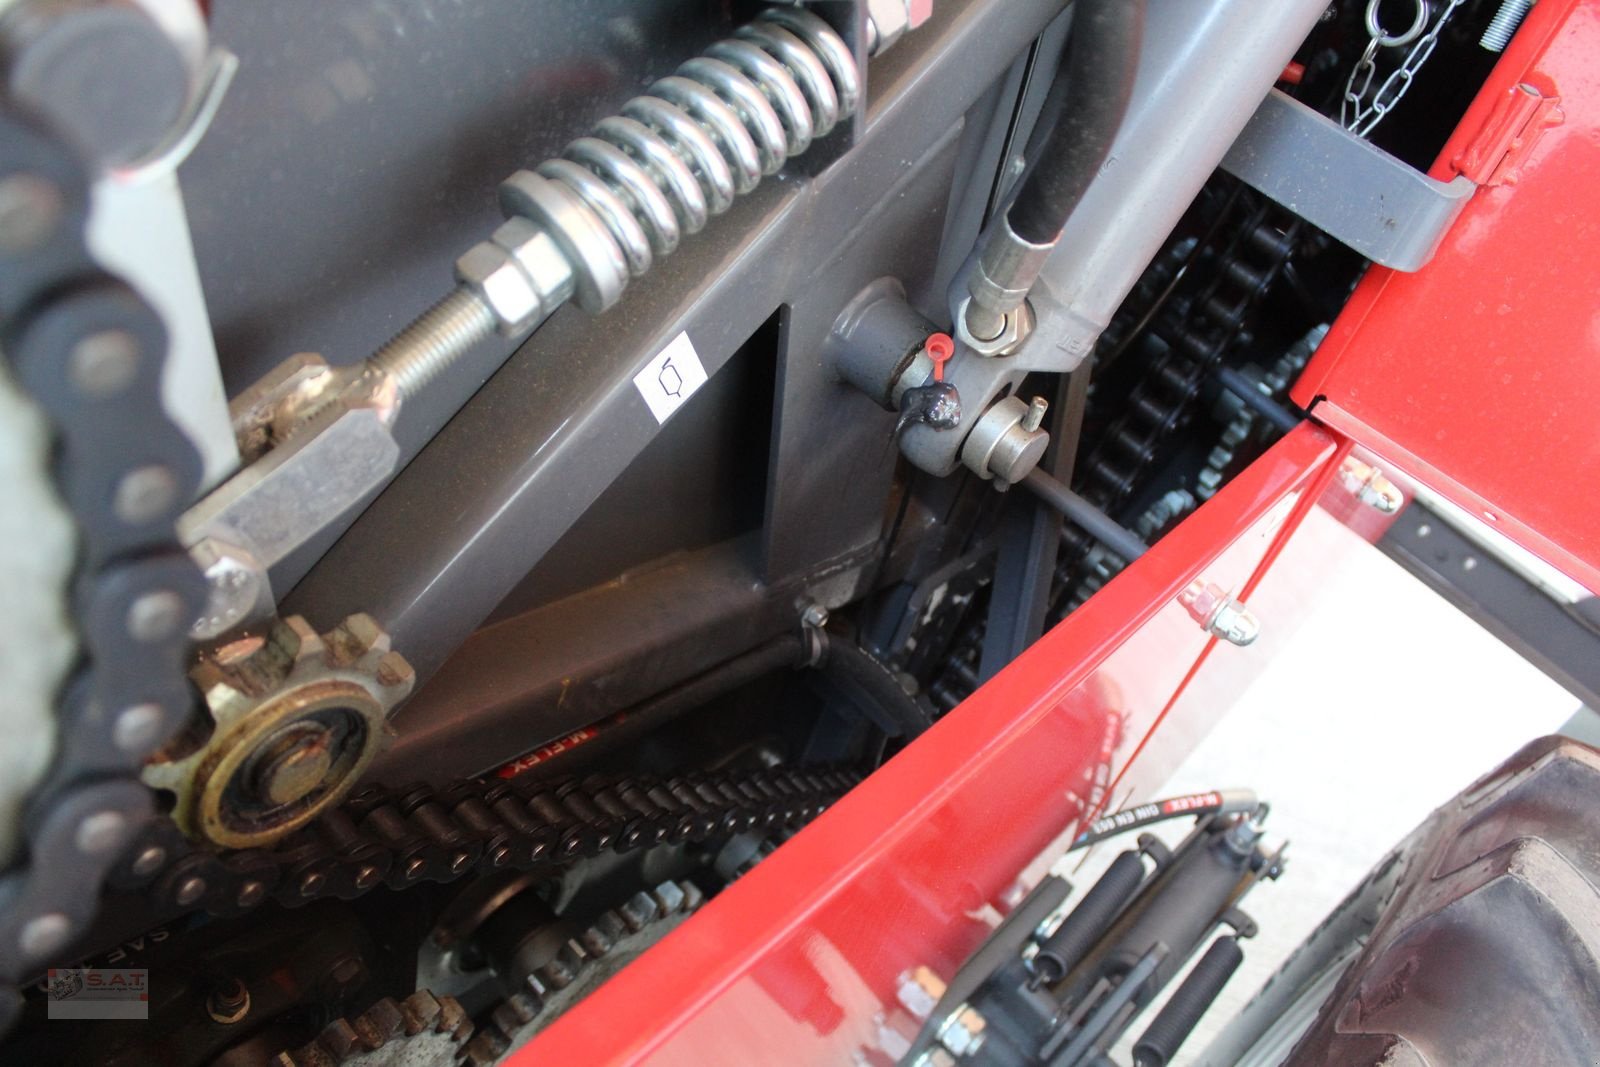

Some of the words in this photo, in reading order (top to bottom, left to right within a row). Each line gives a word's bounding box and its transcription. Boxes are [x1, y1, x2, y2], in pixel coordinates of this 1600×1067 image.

[509, 730, 588, 773] M-FLEX
[1114, 810, 1136, 827] EN
[1134, 803, 1159, 820] DIN
